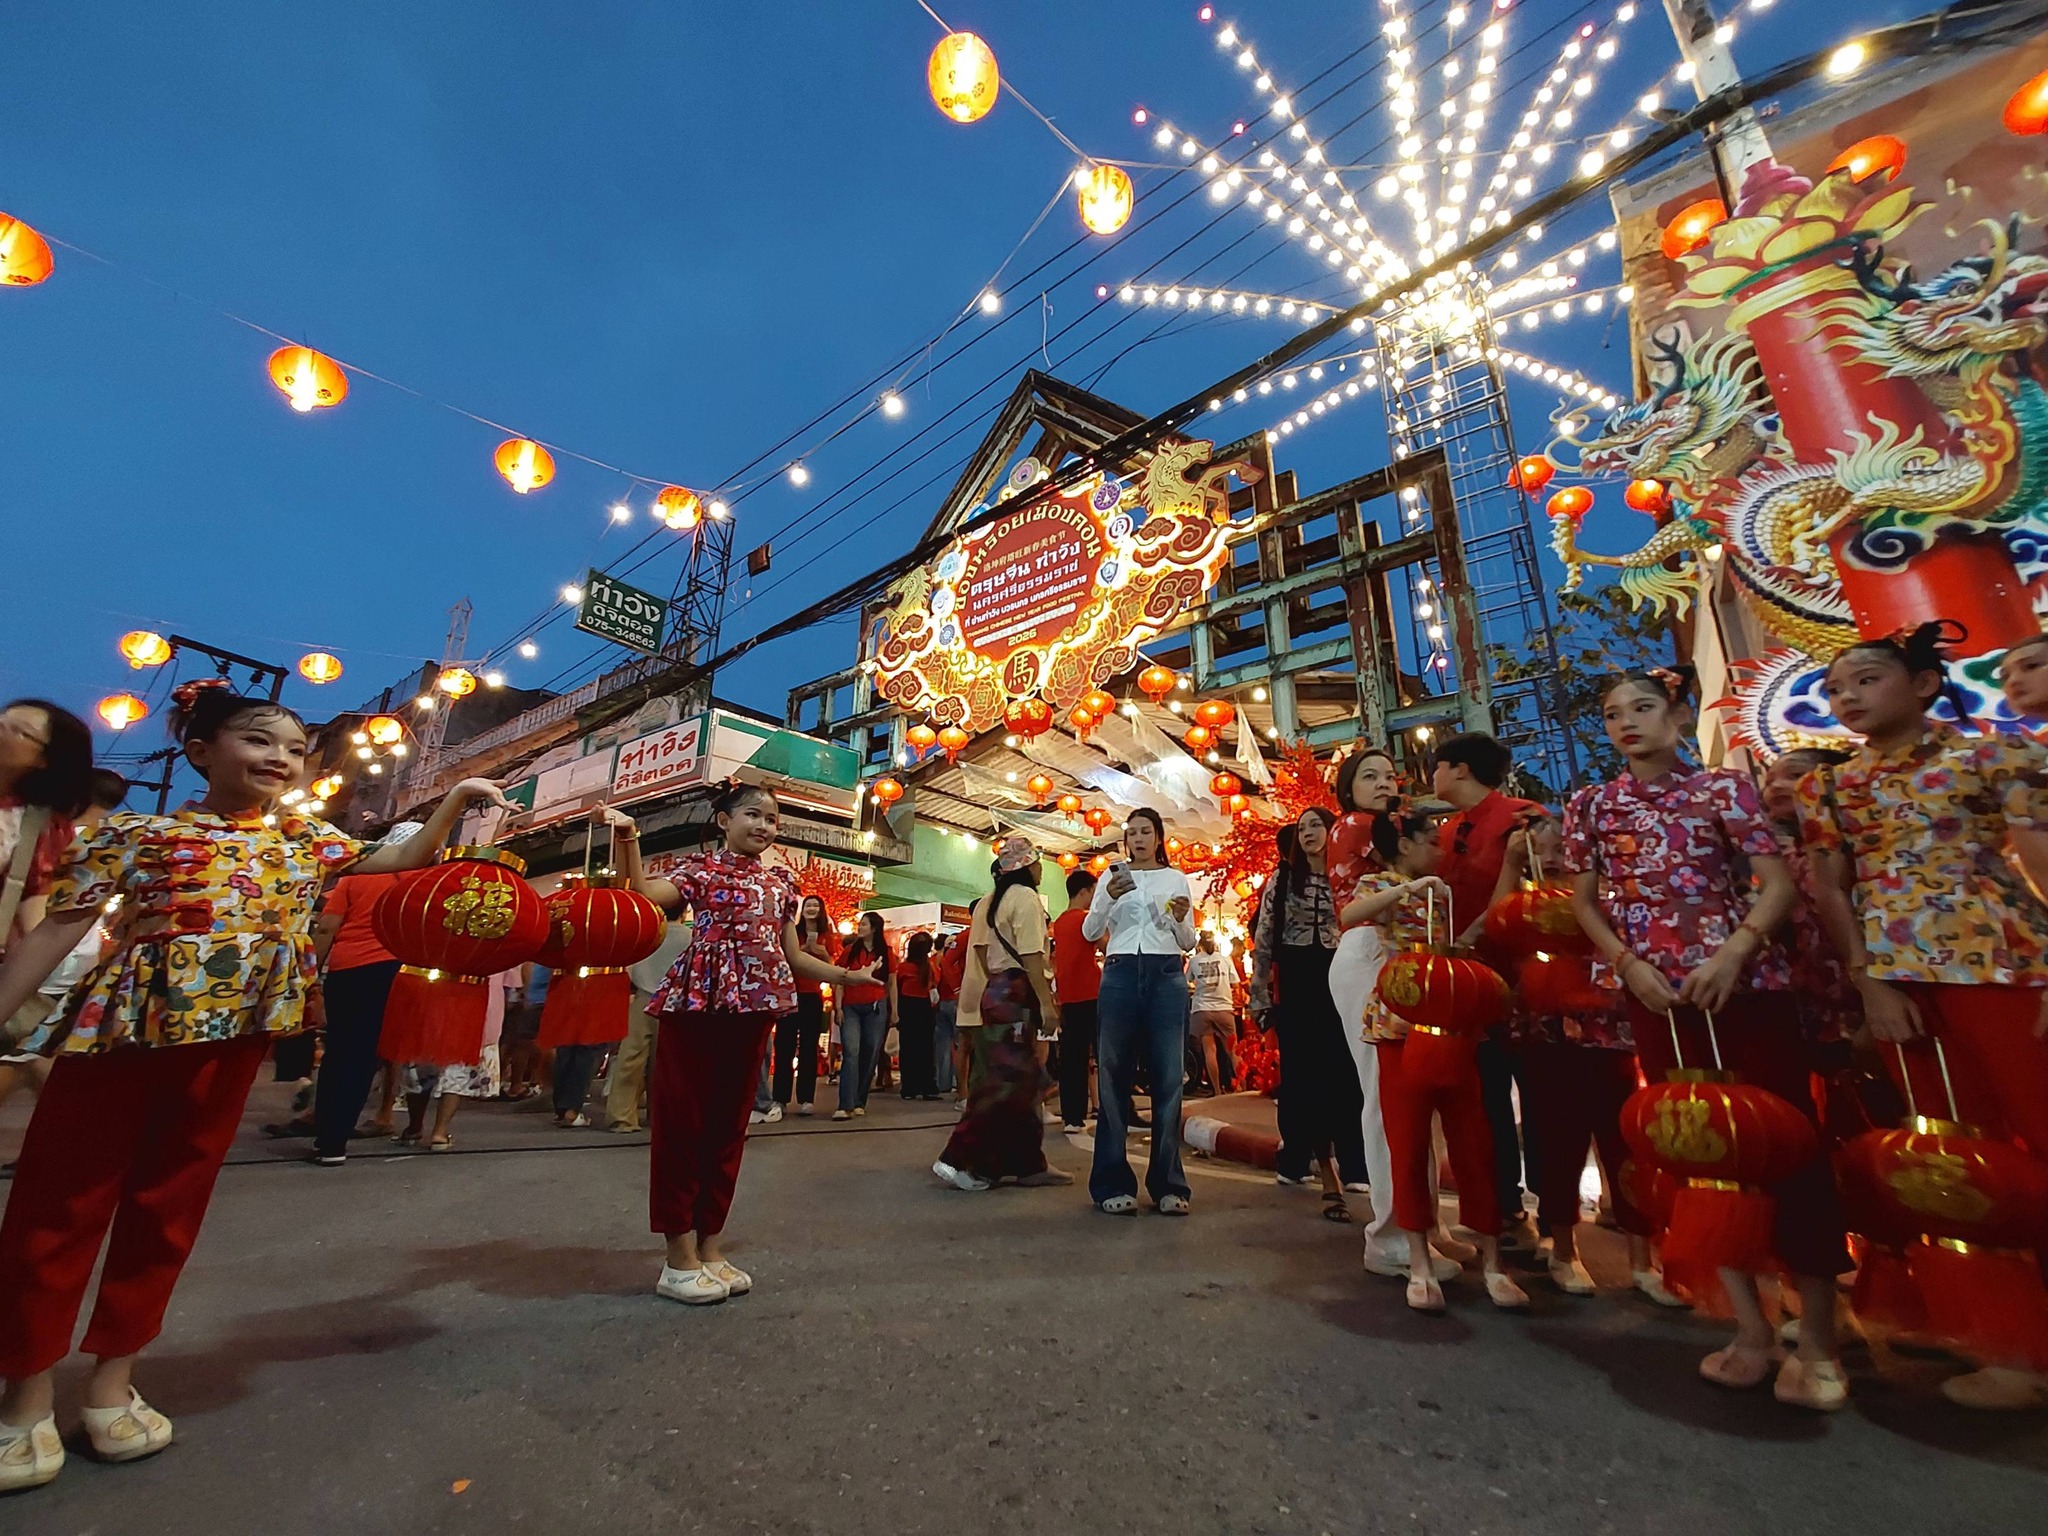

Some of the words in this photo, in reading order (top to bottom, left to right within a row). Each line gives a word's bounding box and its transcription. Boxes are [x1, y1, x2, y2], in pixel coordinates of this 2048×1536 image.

[970, 561, 1031, 597] ตรุษจีน
[1035, 541, 1081, 570] ท่าวัง
[973, 559, 1079, 611] นครศรีธรรมราช
[591, 579, 661, 622] ท่าวัง
[592, 601, 654, 636] ดิจิตอล
[1013, 611, 1027, 621] NEW
[1042, 600, 1057, 611] FOOD
[586, 616, 656, 649] 075-346562
[1007, 628, 1037, 647] 2026
[1008, 651, 1035, 691] 馬
[620, 730, 697, 770] ท่าวัง
[442, 876, 516, 939] 福
